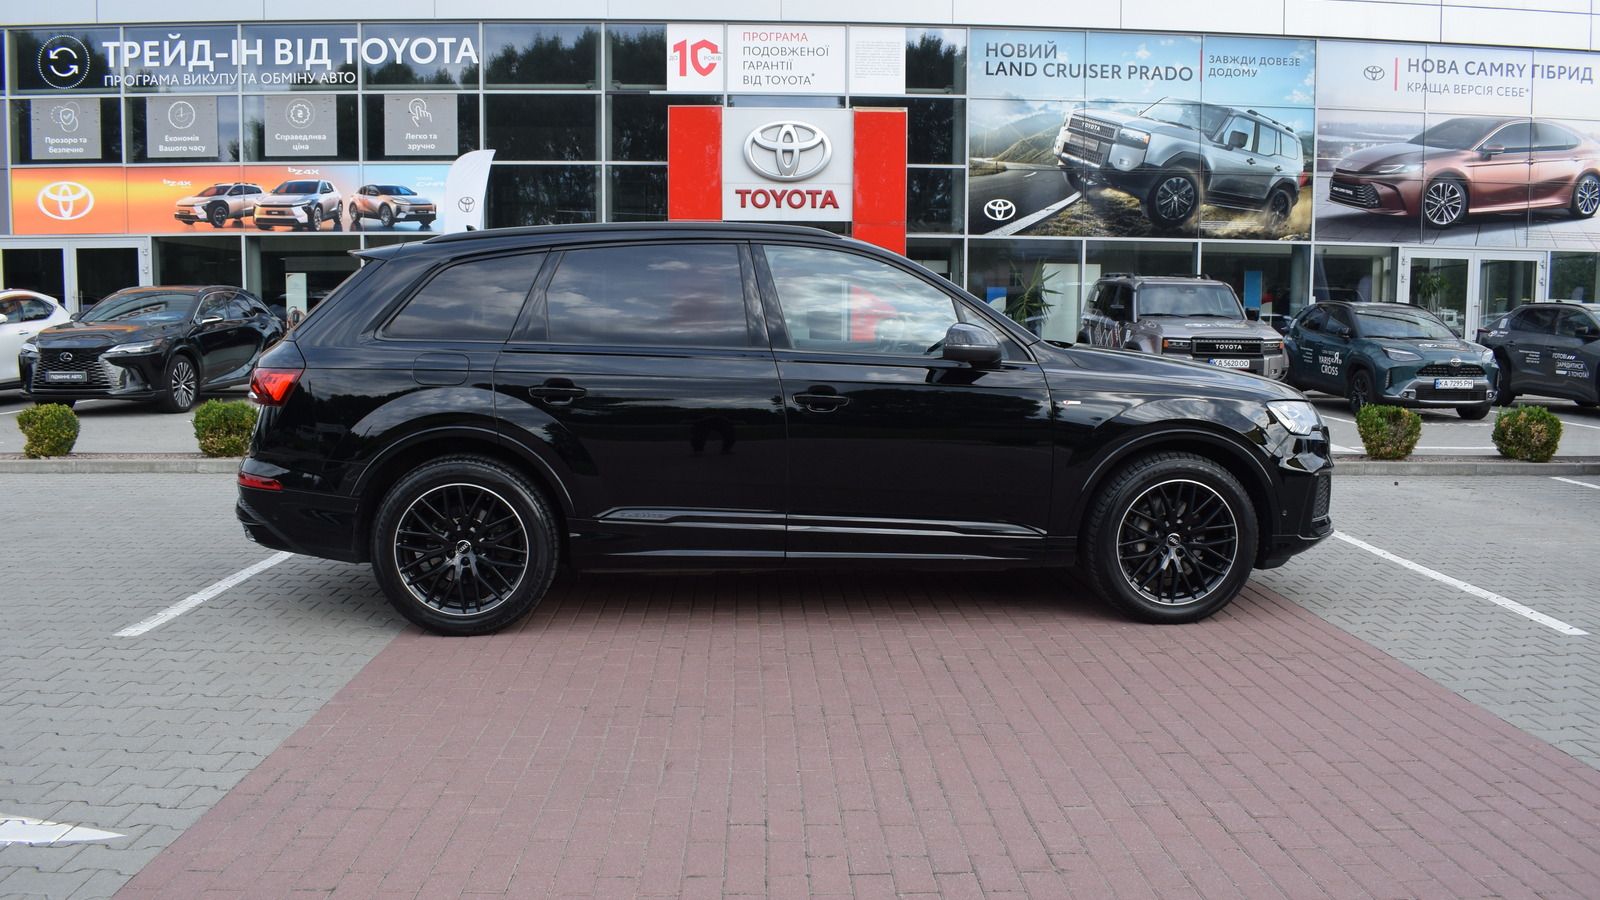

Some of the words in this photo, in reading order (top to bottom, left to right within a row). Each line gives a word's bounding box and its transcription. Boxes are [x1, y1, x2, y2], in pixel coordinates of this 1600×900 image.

[742, 32, 809, 42] ПРОГРАМА
[102, 33, 263, 72] ТРЕЙД-ІН
[275, 38, 332, 71] ВІД
[340, 37, 479, 65] TOYOTA
[742, 45, 830, 57] ПОДОВЖЕНОЇ
[985, 41, 1058, 59] НОВИЙ
[742, 59, 793, 71] ГАРАНТІЇ
[1208, 54, 1256, 67] ЗАВЖДИ
[1258, 56, 1301, 68] ДОВЕЗЕ
[985, 60, 1037, 78] LAND
[1042, 62, 1122, 80] CRUISER
[1127, 65, 1194, 82] PRADO
[1208, 67, 1258, 78] ДОДОМУ
[1407, 58, 1459, 75] НОВА
[1464, 60, 1526, 78] CAMRY
[1531, 64, 1594, 85] ГІБРИД
[104, 73, 180, 87] ПРОГРАМА
[184, 73, 238, 85] ВИКУПУ
[240, 72, 257, 85] ТА
[261, 72, 317, 84] ОБМІНУ
[319, 71, 356, 84] АВТО
[742, 75, 762, 86] ВІД
[1407, 82, 1450, 95] КРАЩА
[1453, 84, 1493, 97] ВЕРСІЯ
[1081, 122, 1100, 131] TOYOTA
[45, 136, 79, 146] Прозоро
[164, 134, 200, 142] Економія
[275, 133, 327, 142] Справедлива
[48, 145, 84, 153] безпечно
[158, 144, 186, 152] Вашого
[186, 145, 206, 153] часу
[292, 142, 310, 151] ціна
[407, 142, 436, 151] зручно
[735, 188, 840, 209] TOYOTA
[1223, 359, 1239, 367] 5620
[1320, 364, 1339, 376] CROSS
